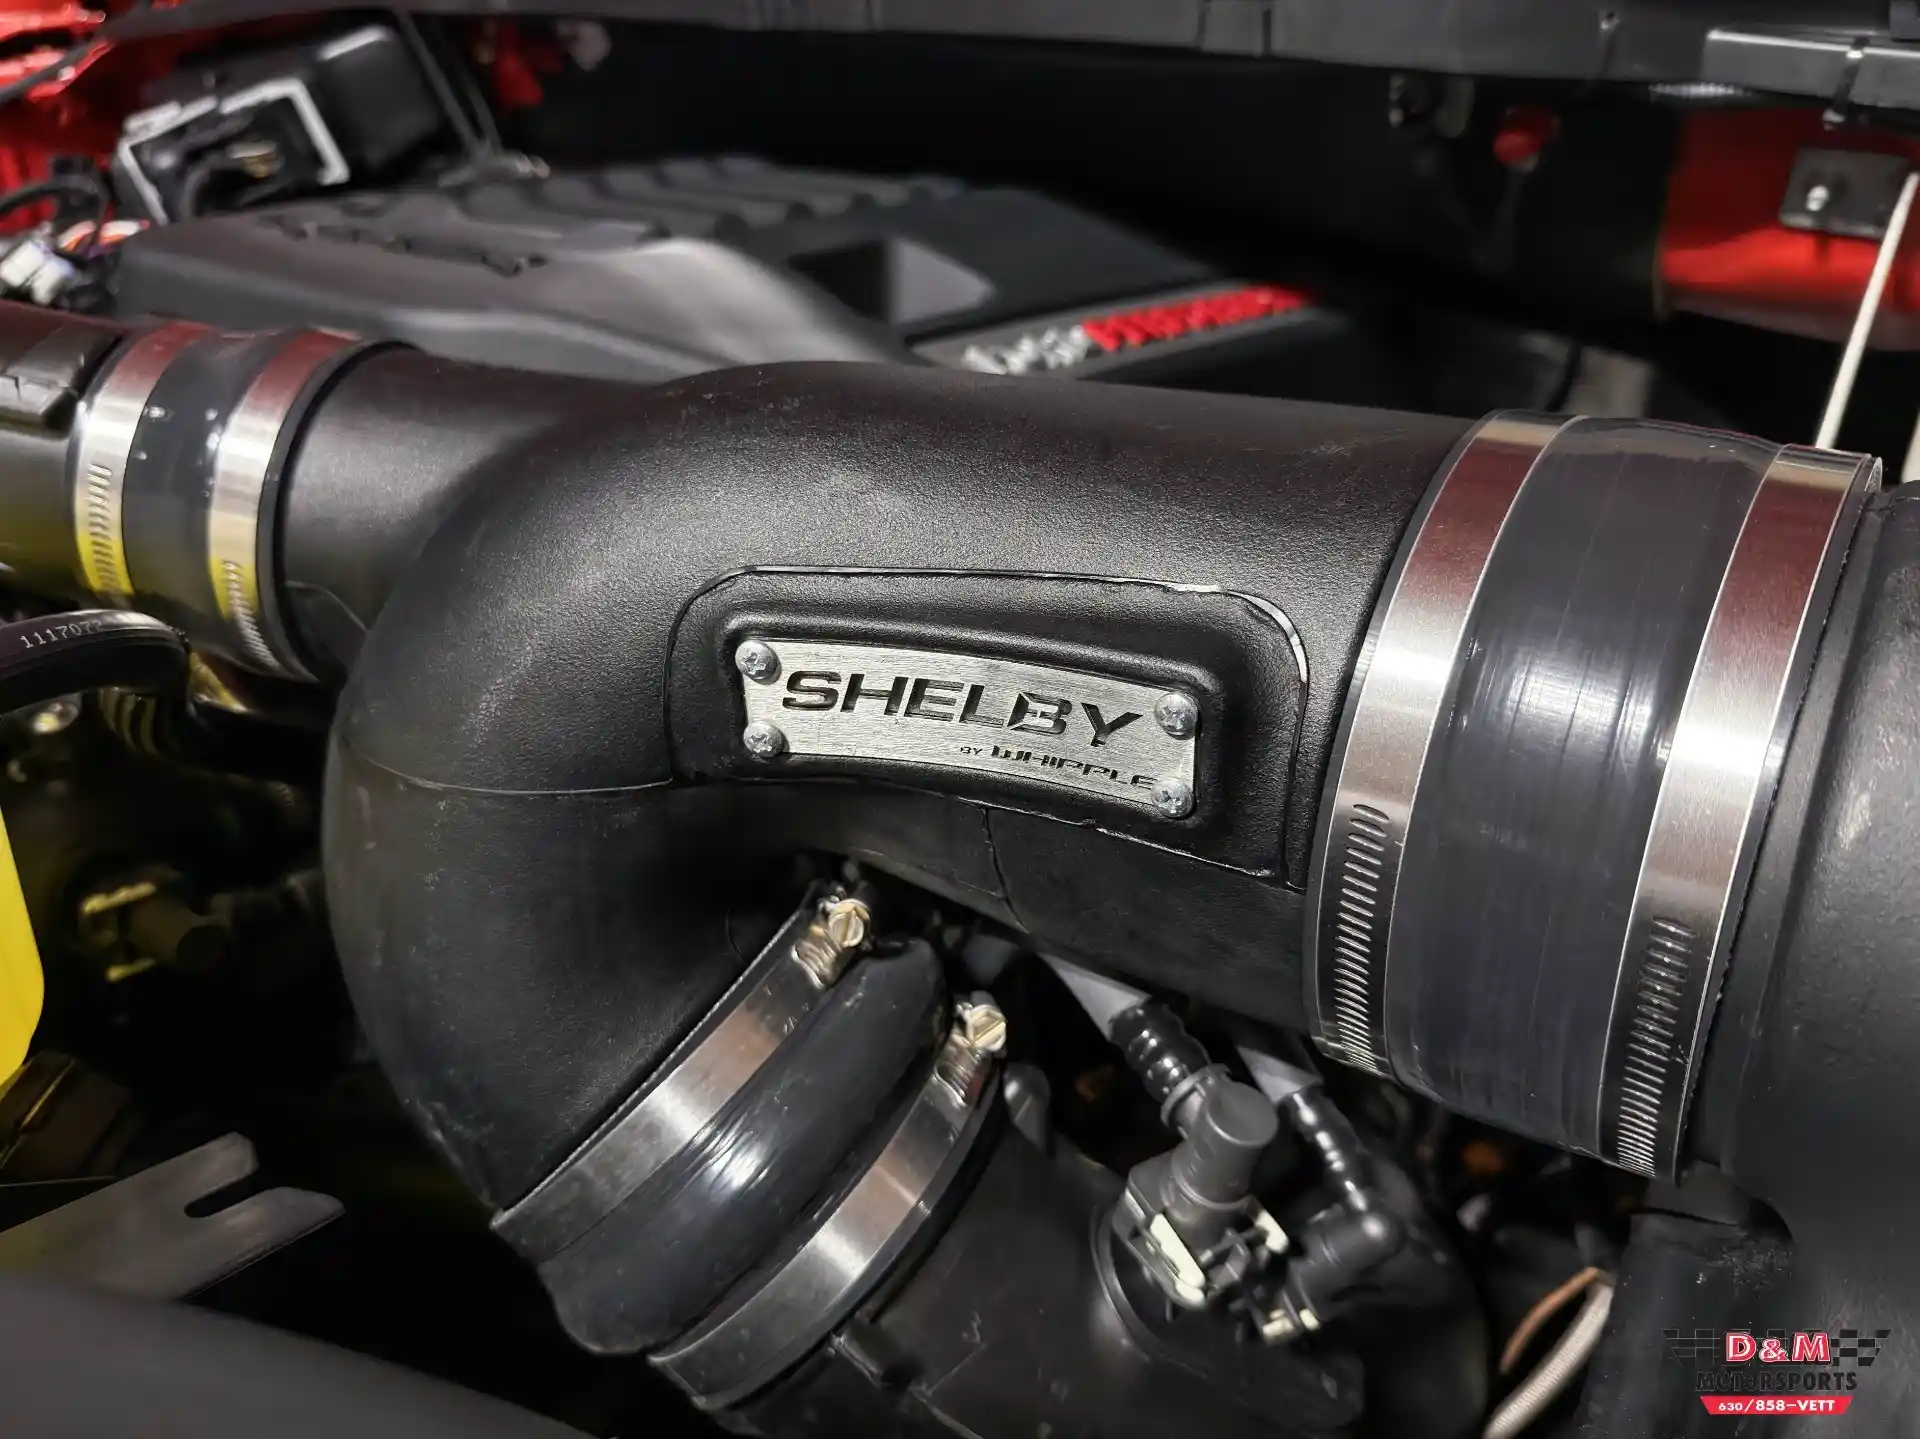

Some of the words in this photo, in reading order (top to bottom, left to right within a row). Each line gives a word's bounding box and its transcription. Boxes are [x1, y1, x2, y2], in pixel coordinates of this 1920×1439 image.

[782, 670, 1144, 747] SHELBY
[959, 745, 983, 756] BY
[991, 744, 1158, 790] WHIPPLE
